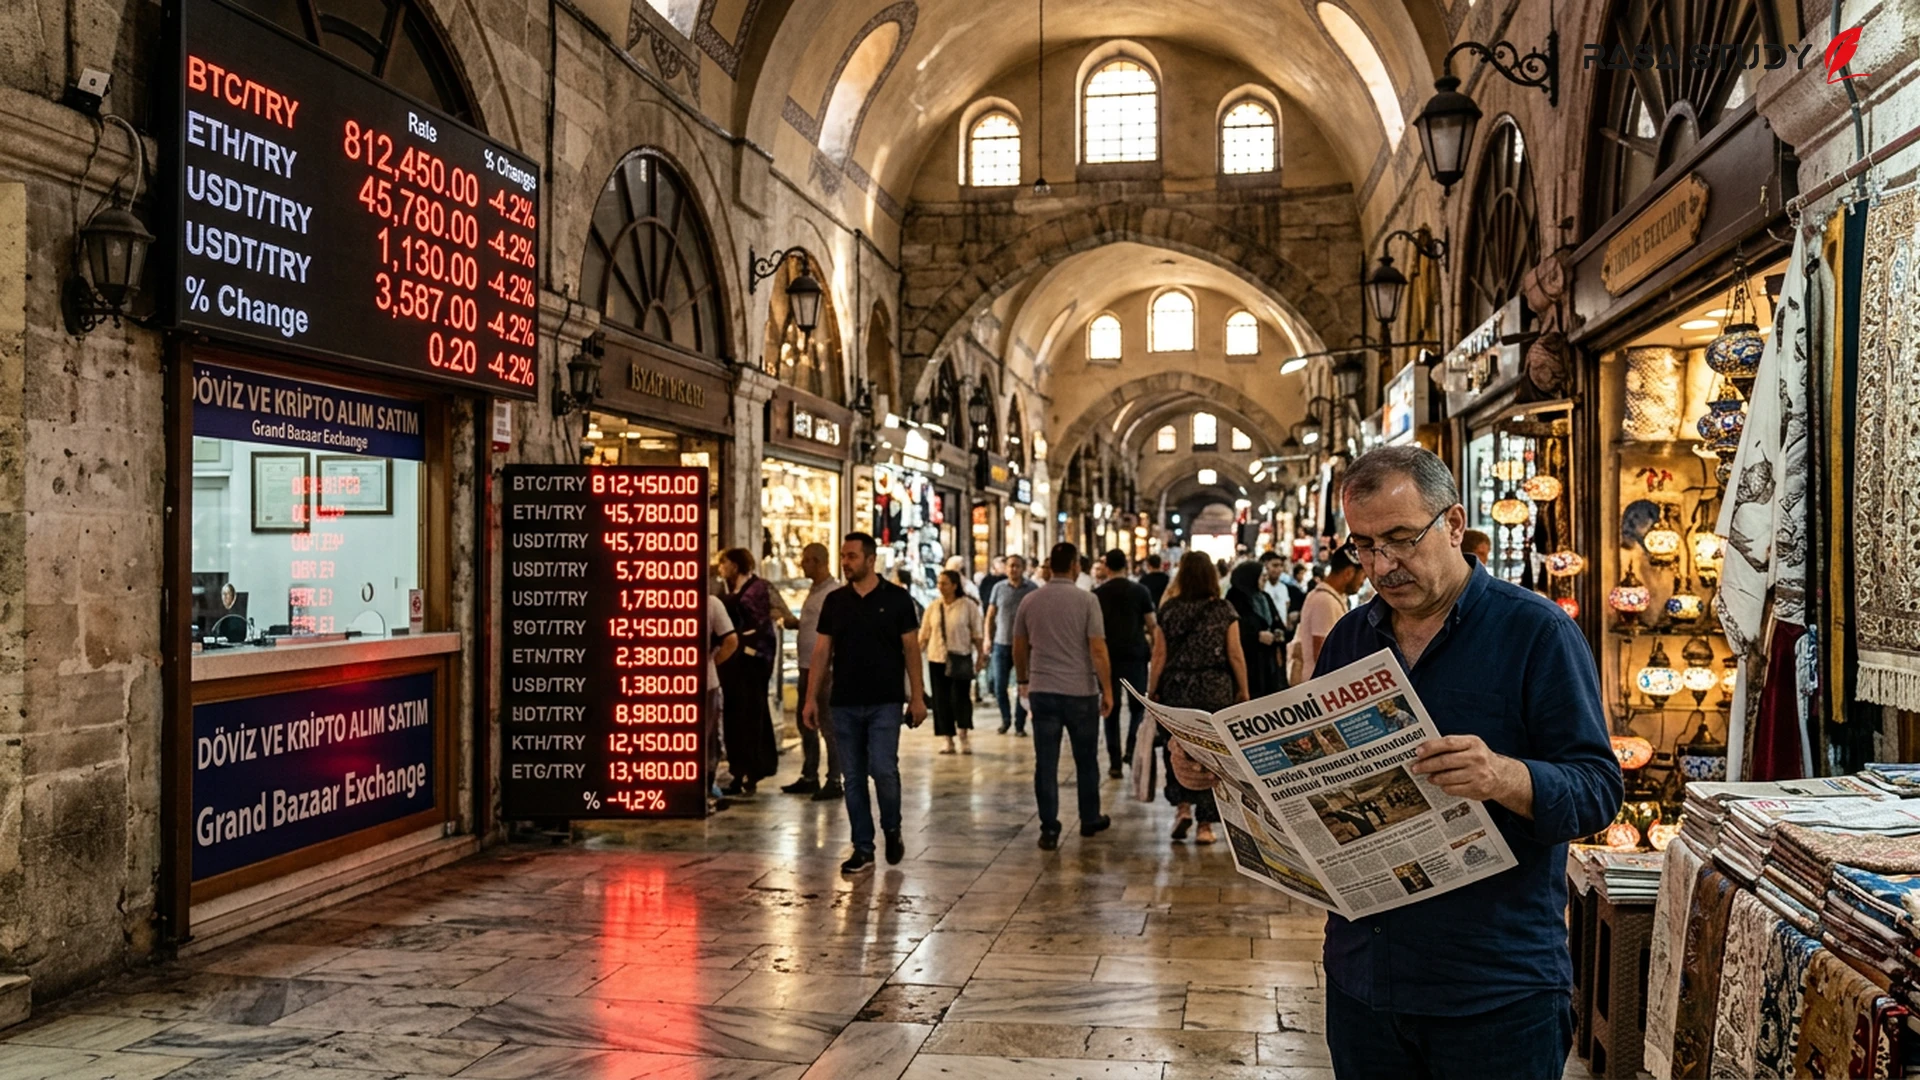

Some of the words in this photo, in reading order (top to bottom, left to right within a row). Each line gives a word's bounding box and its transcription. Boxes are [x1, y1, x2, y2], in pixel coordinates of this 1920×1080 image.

[187, 54, 299, 129] BTC/TRY
[344, 119, 479, 208] 812,450.00
[488, 188, 536, 229] -4.2%
[187, 109, 297, 179] ETH/TRY
[358, 175, 478, 249] 45,780.00
[487, 229, 536, 269] -4.2%
[186, 165, 313, 235] USDT/TRY
[378, 227, 478, 291] 1,130.00
[487, 270, 536, 308] -4.2%
[185, 220, 312, 284] USDT/TRY
[375, 272, 477, 332] 3,587.00
[487, 310, 535, 347] -4.2%
[185, 275, 209, 312] %
[218, 284, 309, 338] Change
[428, 331, 477, 374] 0.20
[487, 351, 535, 387] -4.2%
[247, 385, 272, 413] VE
[274, 387, 335, 423] KRİPTO
[337, 400, 374, 428] ALIM
[377, 406, 419, 436] SATIM
[251, 419, 286, 439] Grand
[287, 424, 322, 444] Bazaar
[323, 429, 369, 452] Exchange
[513, 475, 586, 492] BTC/TRY
[513, 504, 587, 520] ETH/TRY
[604, 503, 698, 525] 45,780.00
[512, 533, 588, 549] USDT/TRY
[604, 532, 698, 554] 45,780.00
[512, 561, 588, 578] USDT/TRY
[616, 560, 698, 582] 5,780.00
[512, 590, 588, 607] USDT/TRY
[620, 589, 698, 611] 1,780.00
[608, 617, 698, 640] 12,450.00
[616, 646, 698, 669] 2,380.00
[620, 675, 698, 697] 1,380.00
[1320, 668, 1398, 713] HABER
[615, 703, 698, 726] 8,980.00
[197, 722, 257, 771] DÖVİZ
[261, 723, 284, 757] VE
[286, 711, 347, 752] KRİPTO
[349, 705, 386, 740] ALIM
[387, 698, 429, 732] SATIM
[512, 735, 586, 751] KTH/TRY
[608, 732, 698, 755] 12,450.00
[512, 763, 586, 780] ETG/TRY
[608, 760, 698, 783] 13,480.00
[196, 791, 267, 848] Grand
[272, 783, 341, 829] Bazaar
[344, 761, 427, 808] Exchange
[583, 791, 601, 810] %
